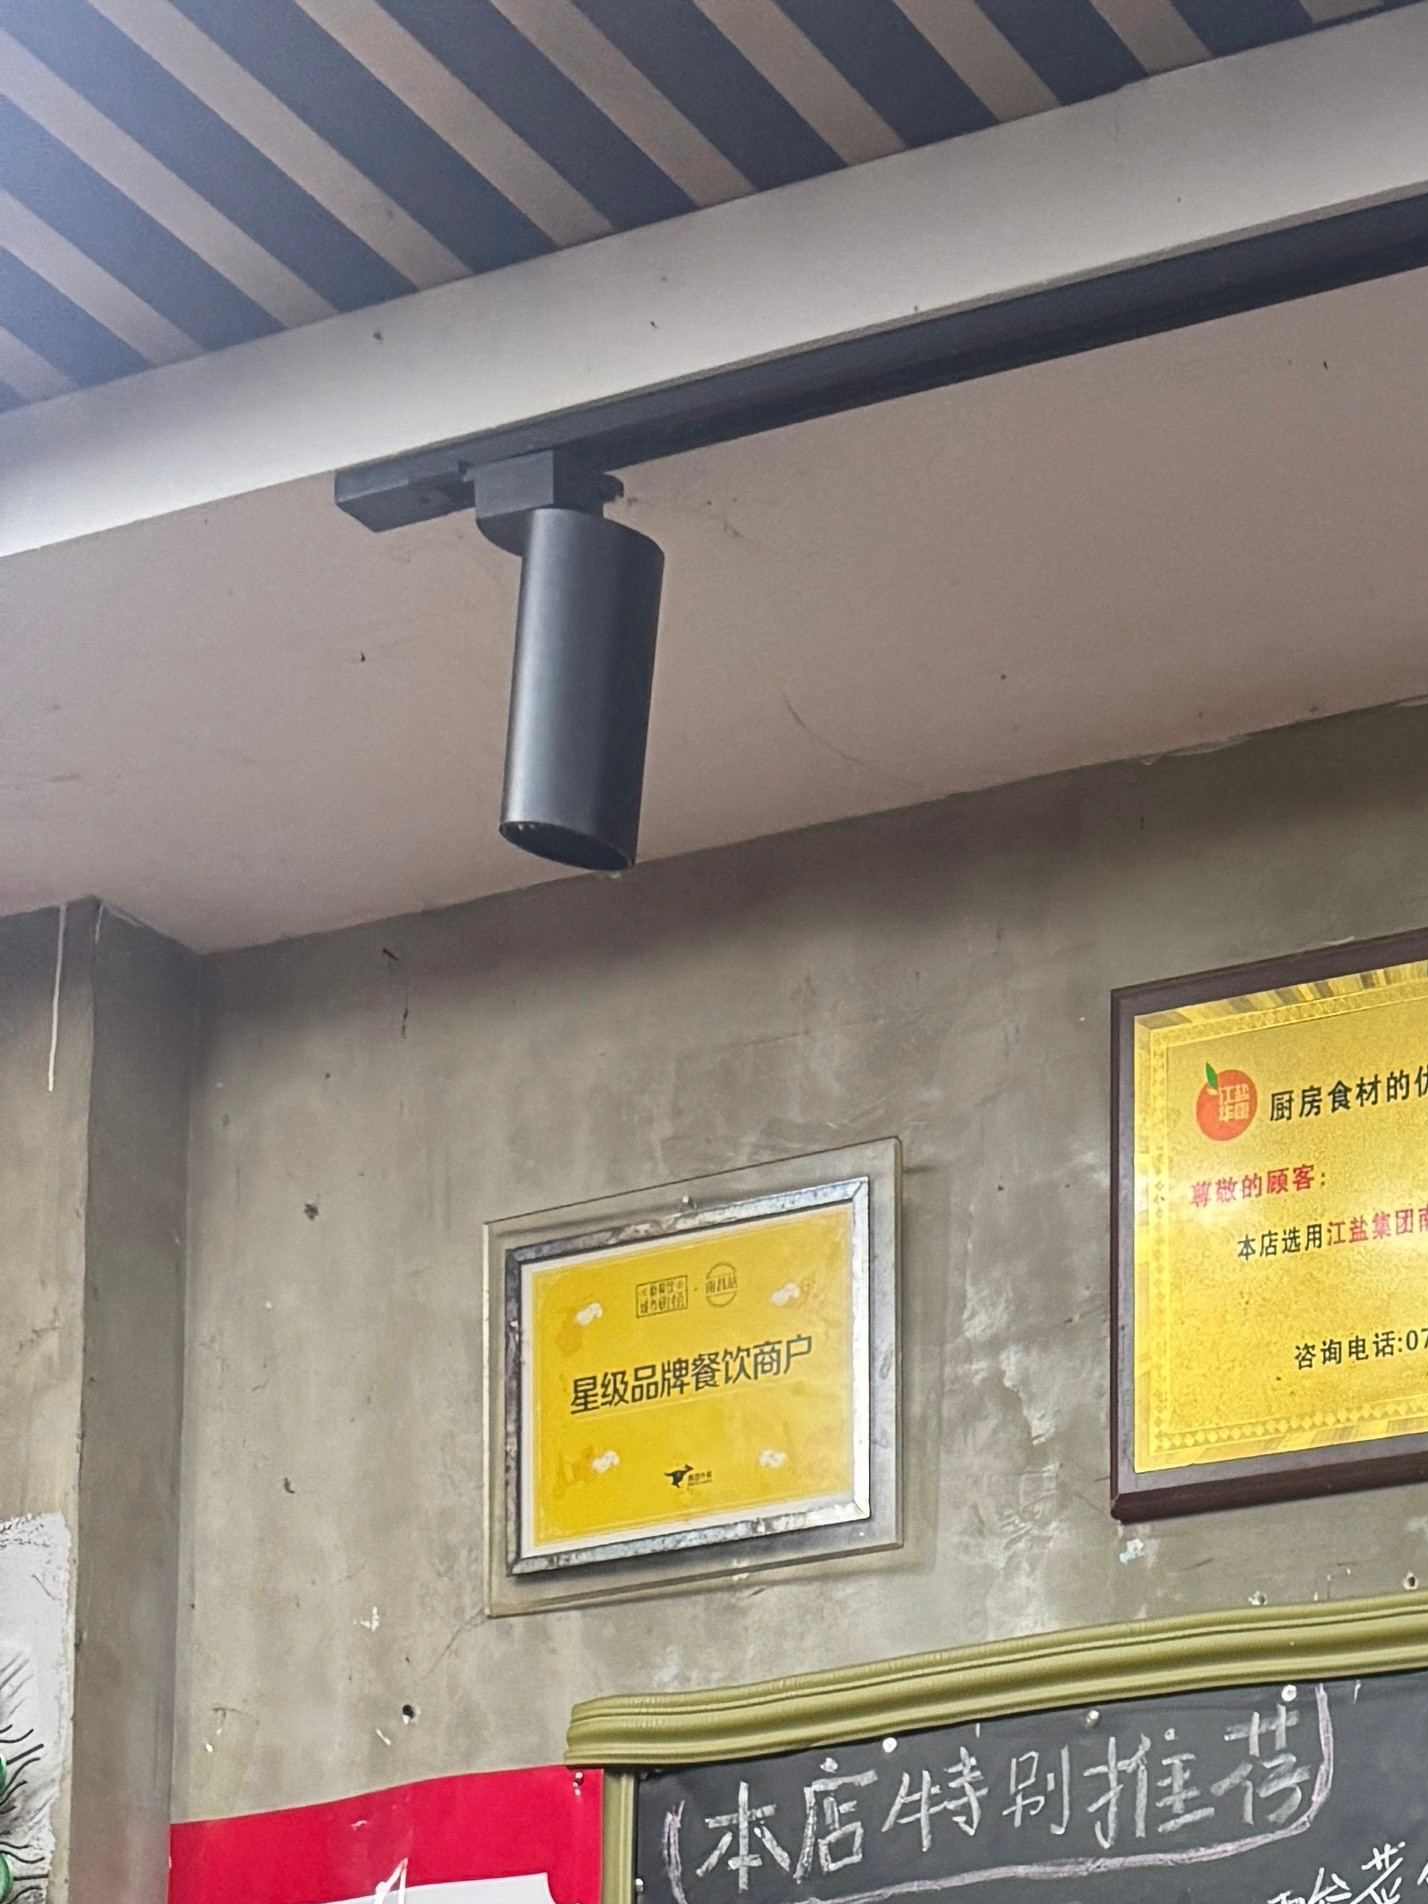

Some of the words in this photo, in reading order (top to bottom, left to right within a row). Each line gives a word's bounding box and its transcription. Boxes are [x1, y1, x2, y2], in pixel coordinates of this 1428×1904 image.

[570, 1334, 813, 1415] 星级品牌餐饮商户
[696, 1704, 1309, 1891] 本店特别推荐
